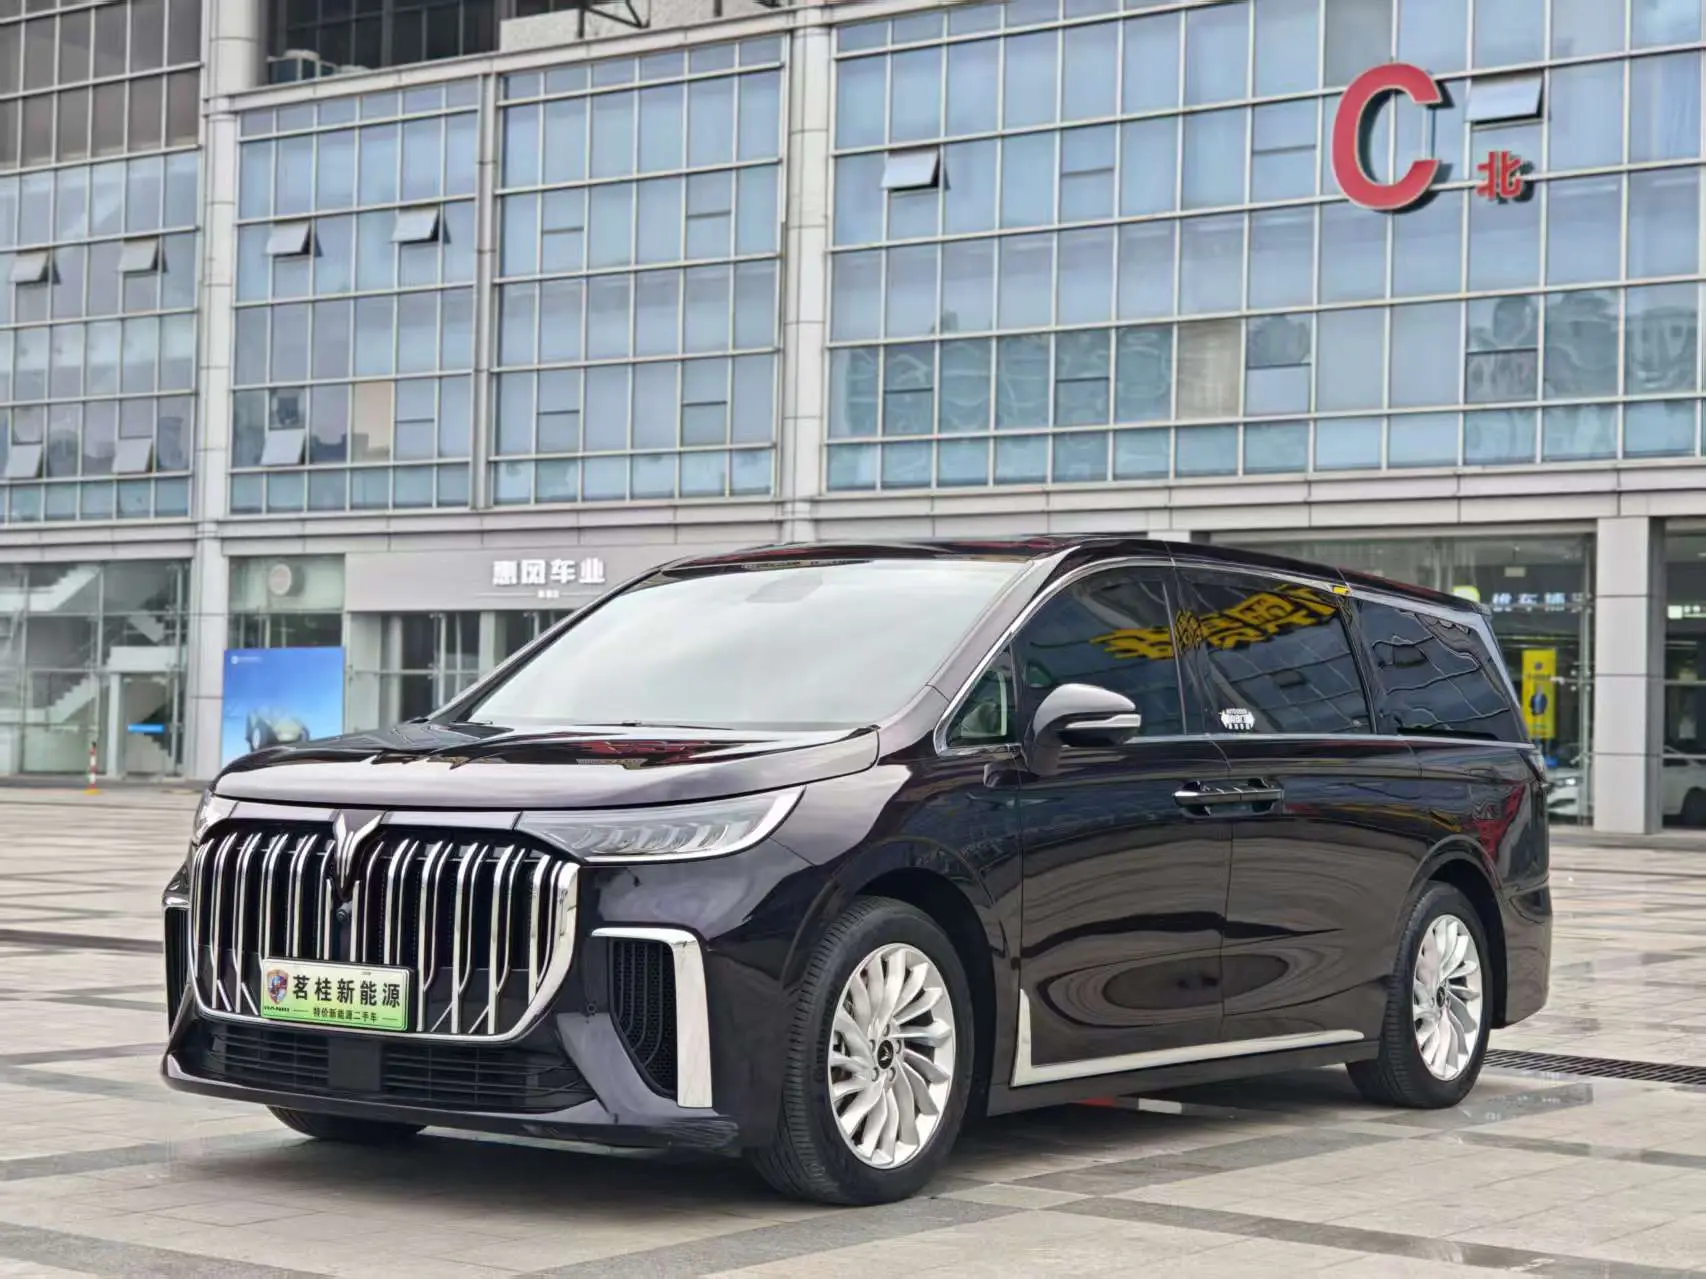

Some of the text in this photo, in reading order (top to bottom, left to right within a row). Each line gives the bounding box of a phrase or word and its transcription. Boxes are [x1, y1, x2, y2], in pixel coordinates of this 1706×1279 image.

[1331, 62, 1443, 210] C
[1476, 150, 1522, 201] 北
[292, 974, 401, 1009] 茗桂新能源
